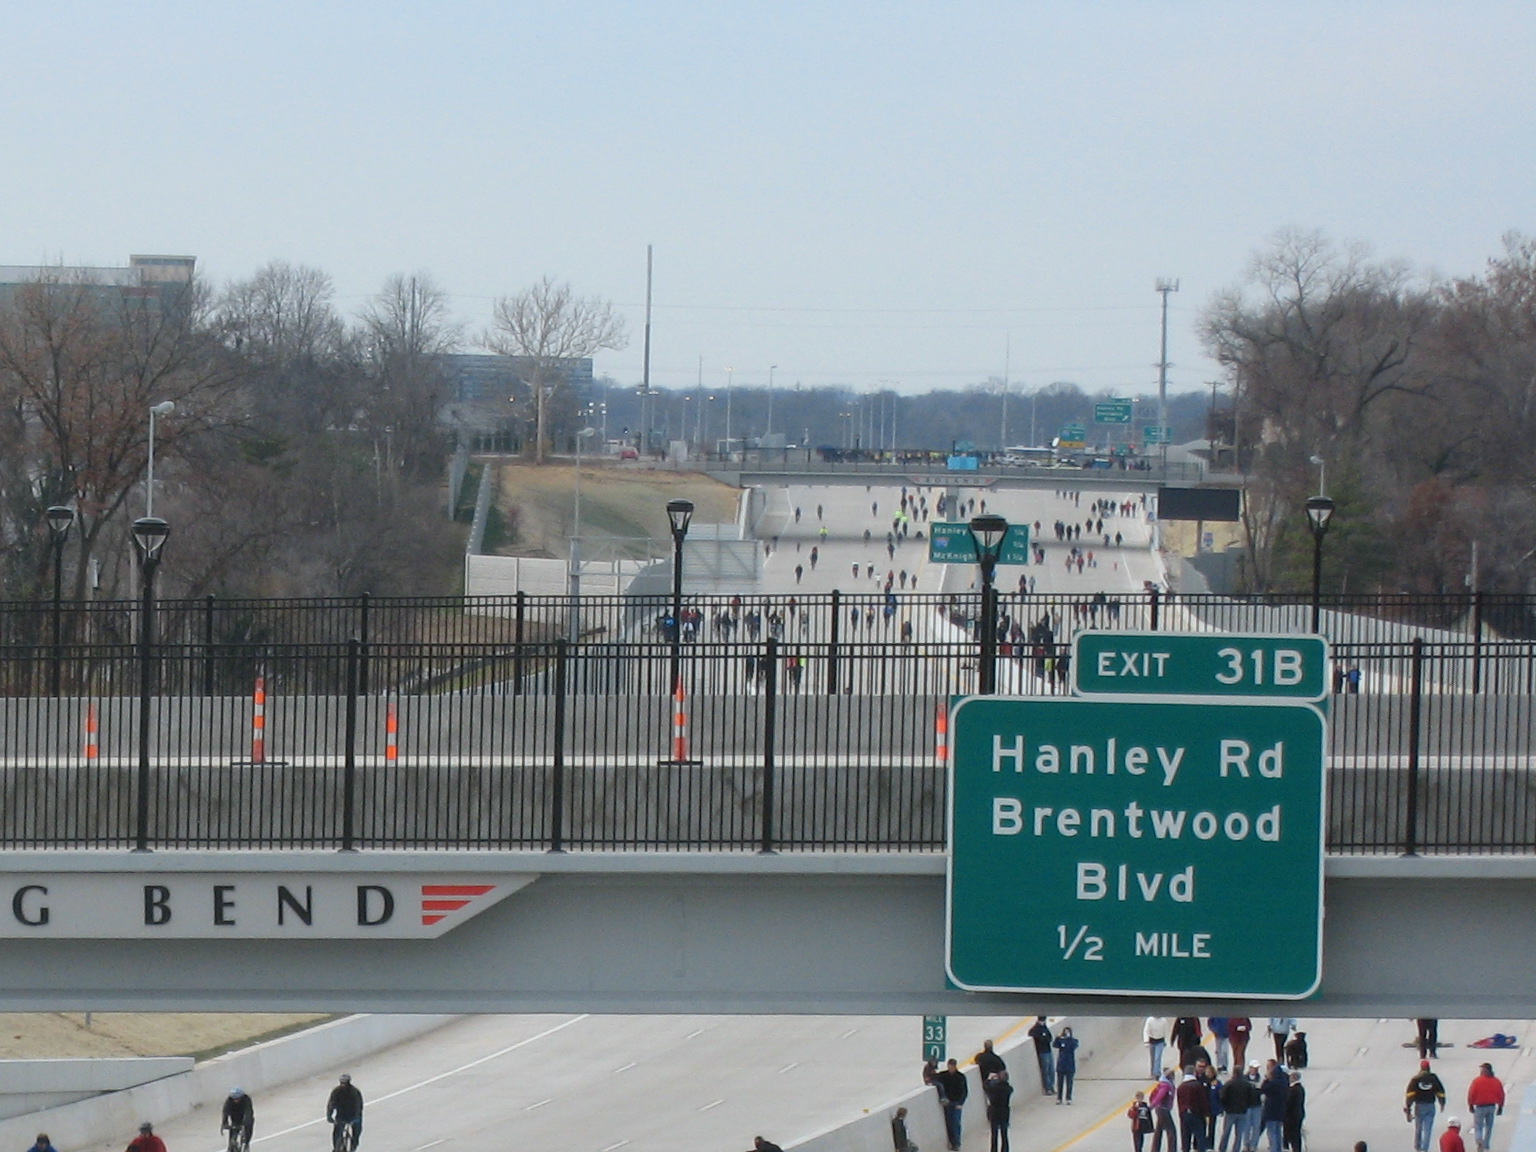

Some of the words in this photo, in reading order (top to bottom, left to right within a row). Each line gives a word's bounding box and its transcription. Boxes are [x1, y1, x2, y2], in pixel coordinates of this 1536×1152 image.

[1098, 652, 1170, 677] EXIT
[1215, 648, 1303, 685] 31B
[991, 735, 1185, 786] Hanley
[1219, 739, 1284, 779] Rd
[992, 798, 1281, 842] Brentwood
[1076, 863, 1195, 903] Blvd
[143, 885, 395, 926] BEND
[1135, 932, 1212, 959] MILE
[925, 1026, 944, 1041] 33
